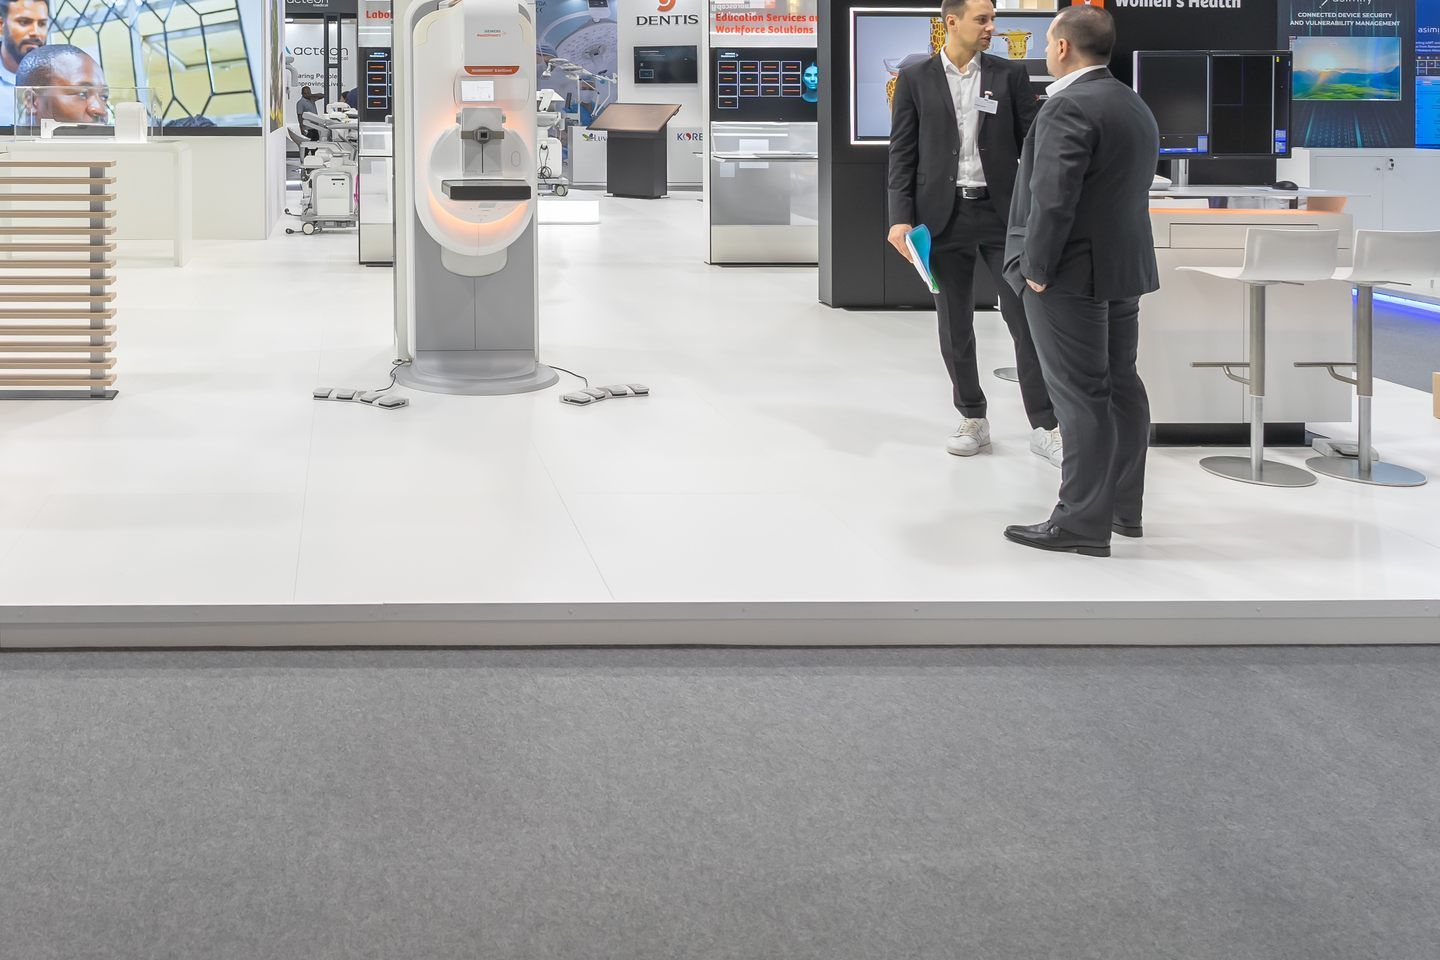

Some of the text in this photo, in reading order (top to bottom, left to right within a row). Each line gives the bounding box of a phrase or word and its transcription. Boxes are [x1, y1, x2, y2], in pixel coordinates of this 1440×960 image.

[636, 14, 699, 26] DENTIS
[715, 13, 764, 22] Education
[767, 13, 806, 22] Services
[715, 26, 814, 35] Workforce Solutions
[1418, 26, 1440, 34] asimi
